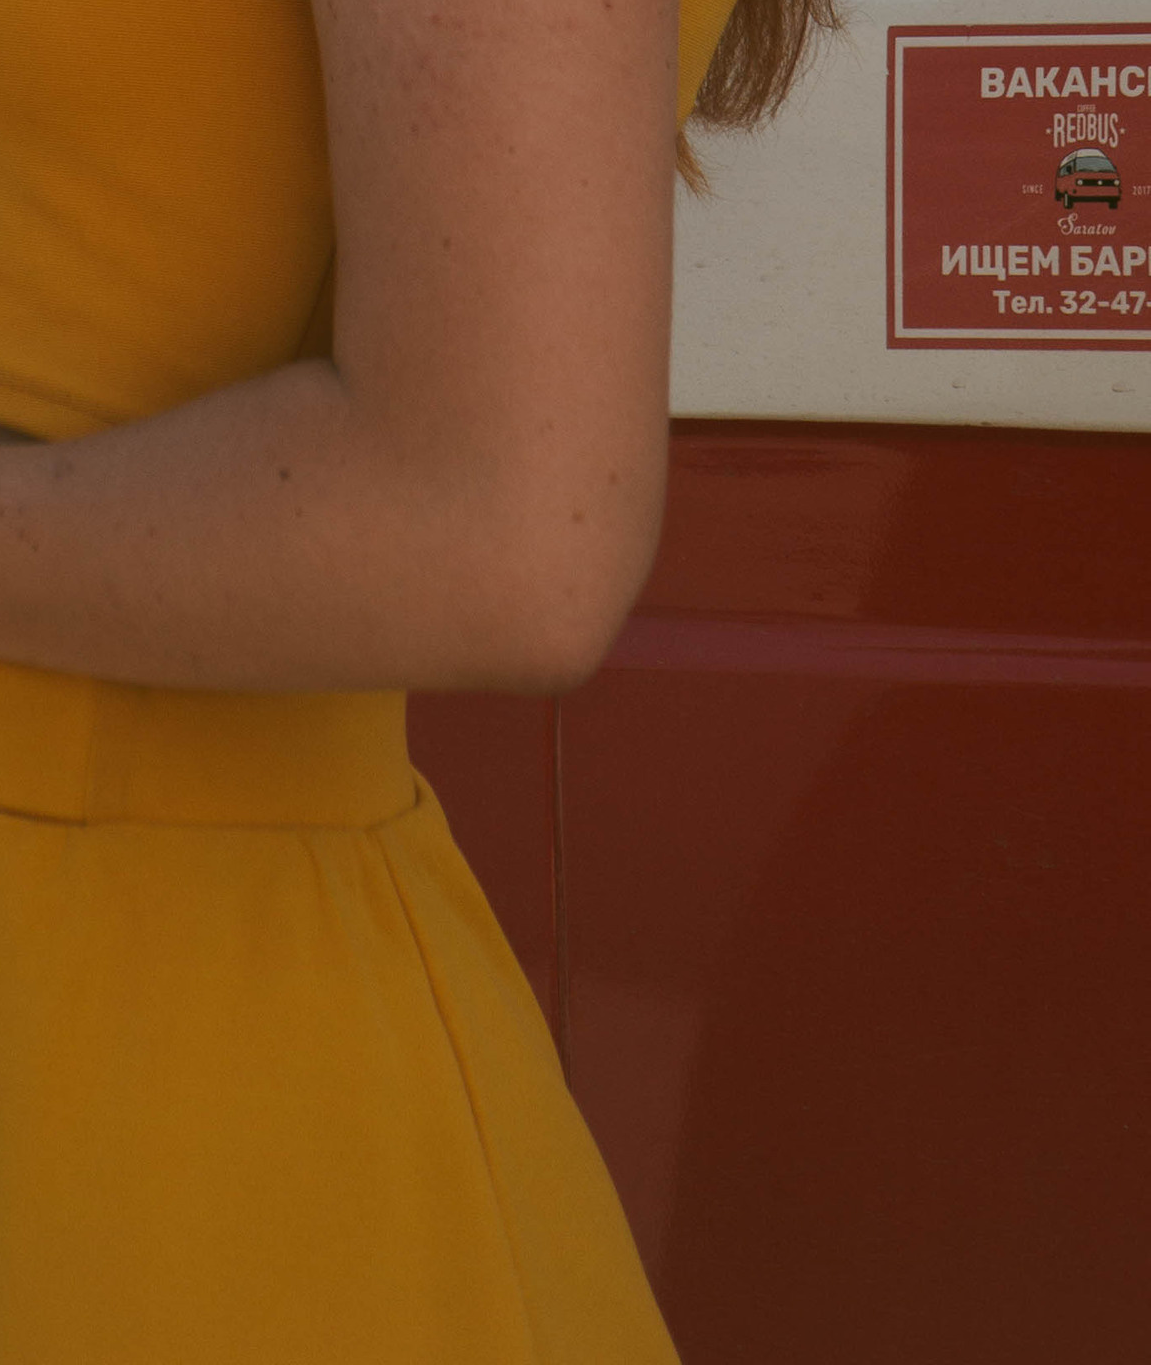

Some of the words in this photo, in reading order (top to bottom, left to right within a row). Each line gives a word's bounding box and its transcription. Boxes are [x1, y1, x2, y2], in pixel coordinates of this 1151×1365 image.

[981, 66, 1151, 98] ВАКАНС
[1053, 112, 1119, 148] REDBUS
[1022, 184, 1043, 195] SINCE
[1057, 212, 1117, 235] Saratov
[941, 244, 1060, 281] ИЩЕМ
[1070, 245, 1151, 277] БАР
[993, 290, 1053, 315] Тел.
